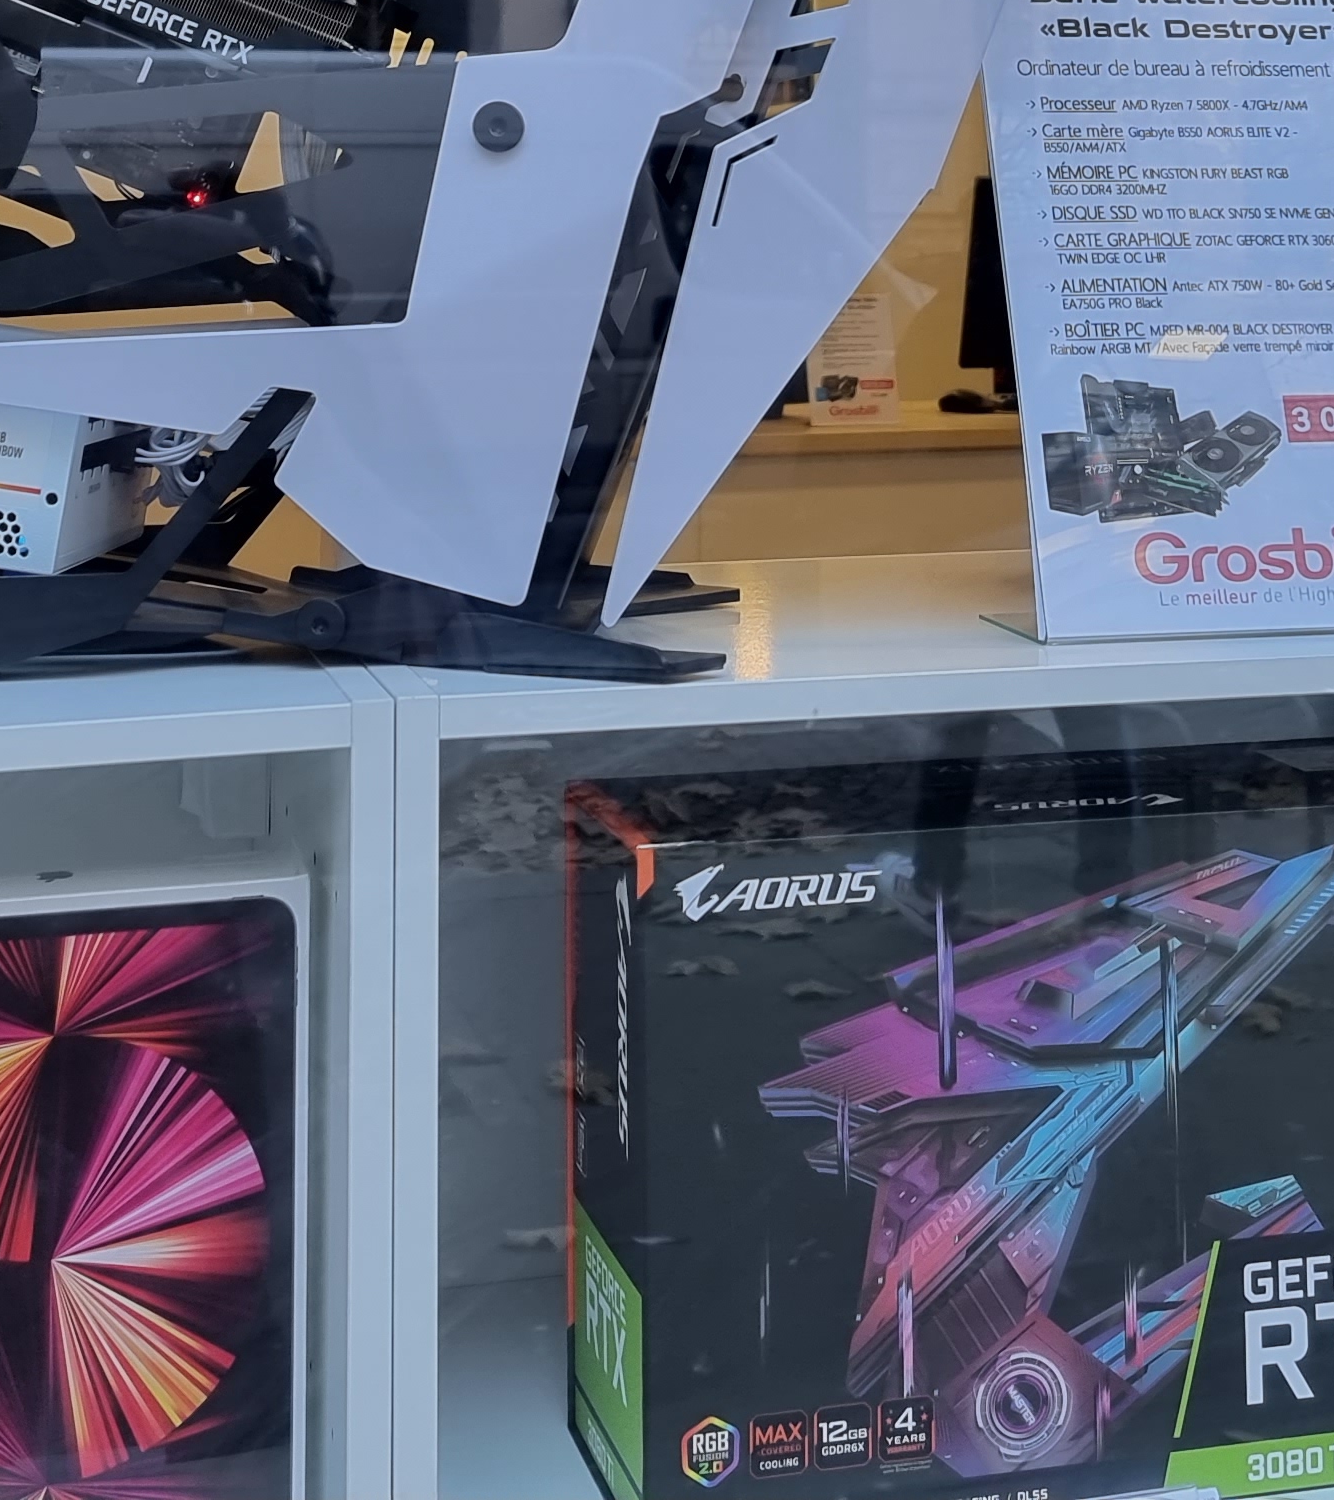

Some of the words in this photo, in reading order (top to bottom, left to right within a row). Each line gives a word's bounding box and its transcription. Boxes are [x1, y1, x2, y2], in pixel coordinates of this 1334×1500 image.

[1039, 17, 1151, 38] «Black
[198, 25, 256, 65] RTX
[1016, 59, 1102, 77] Ordinateur
[1107, 59, 1130, 77] de
[1134, 60, 1190, 77] bureau
[1195, 60, 1205, 77] à
[1211, 60, 1331, 78] refroidissement
[1040, 96, 1117, 111] Processeur
[1121, 100, 1149, 111] AMD
[1151, 100, 1184, 113] Ryzen
[1187, 100, 1193, 111] 7
[1196, 100, 1230, 111] 5800X
[1160, 590, 1178, 607] Le
[1185, 588, 1258, 606] meilleur
[1263, 587, 1283, 604] de
[712, 870, 883, 913] AORUS
[585, 1234, 627, 1326] GEFORCE
[585, 1268, 628, 1409] RTX
[894, 1407, 917, 1432] 4
[755, 1421, 803, 1446] MAX
[818, 1420, 867, 1443] 12GB
[885, 1432, 927, 1446] YEARS
[692, 1431, 729, 1455] RGB
[821, 1441, 866, 1457] GDDR6X
[692, 1451, 729, 1463] FUSION
[698, 1460, 724, 1476] 2.0
[759, 1456, 800, 1471] COOLING
[1247, 1446, 1325, 1483] 3080
